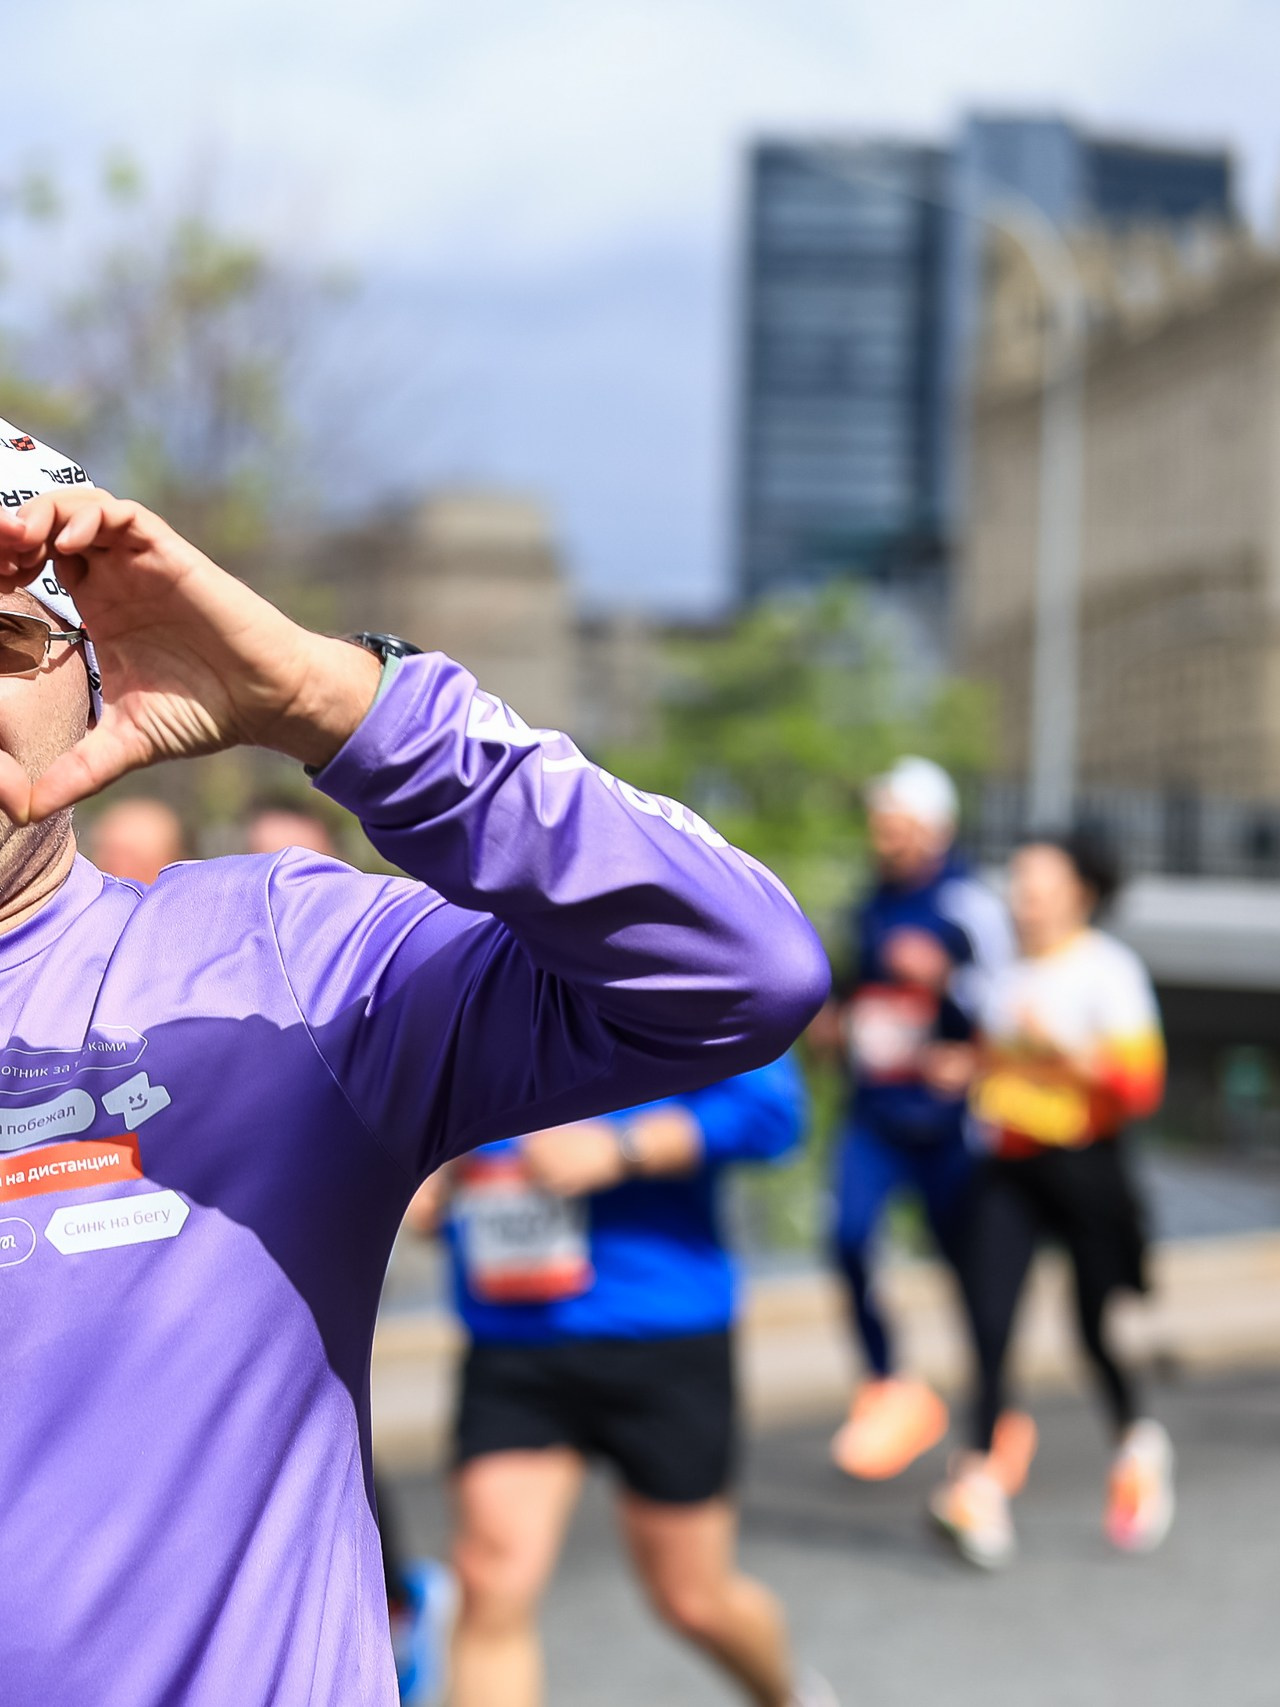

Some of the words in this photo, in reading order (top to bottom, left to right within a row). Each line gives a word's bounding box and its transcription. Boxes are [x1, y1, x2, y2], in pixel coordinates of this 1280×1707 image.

[7, 1105, 76, 1135] побежал
[6, 1172, 25, 1187] на
[27, 1152, 120, 1180] дистанции
[63, 1221, 107, 1237] Синк
[109, 1216, 129, 1230] на
[134, 1207, 172, 1226] бегу
